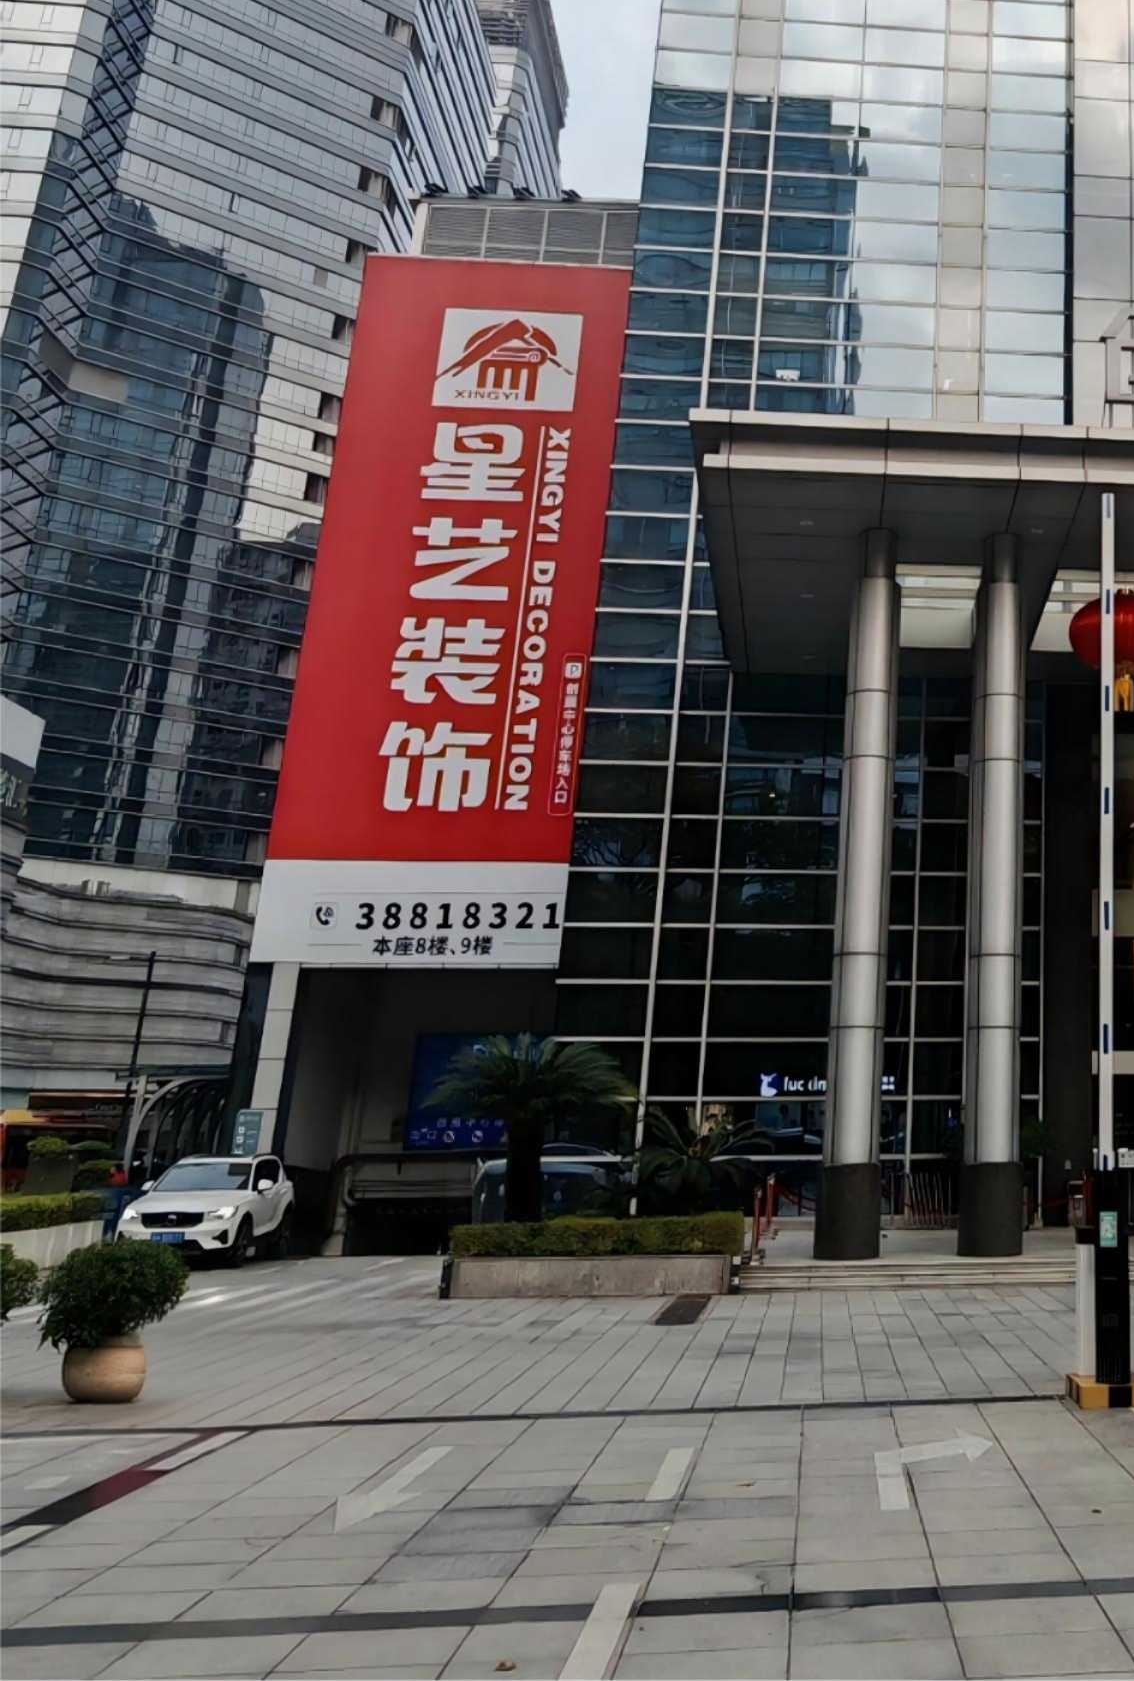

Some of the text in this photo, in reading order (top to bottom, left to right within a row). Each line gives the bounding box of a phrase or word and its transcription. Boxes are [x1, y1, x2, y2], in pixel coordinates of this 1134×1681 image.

[454, 389, 520, 401] XINGYI
[378, 421, 526, 812] 星艺装饰
[503, 427, 572, 811] XINGYI DECORATION
[355, 902, 561, 930] 38818321
[372, 935, 494, 957] 本座8楼、9楼
